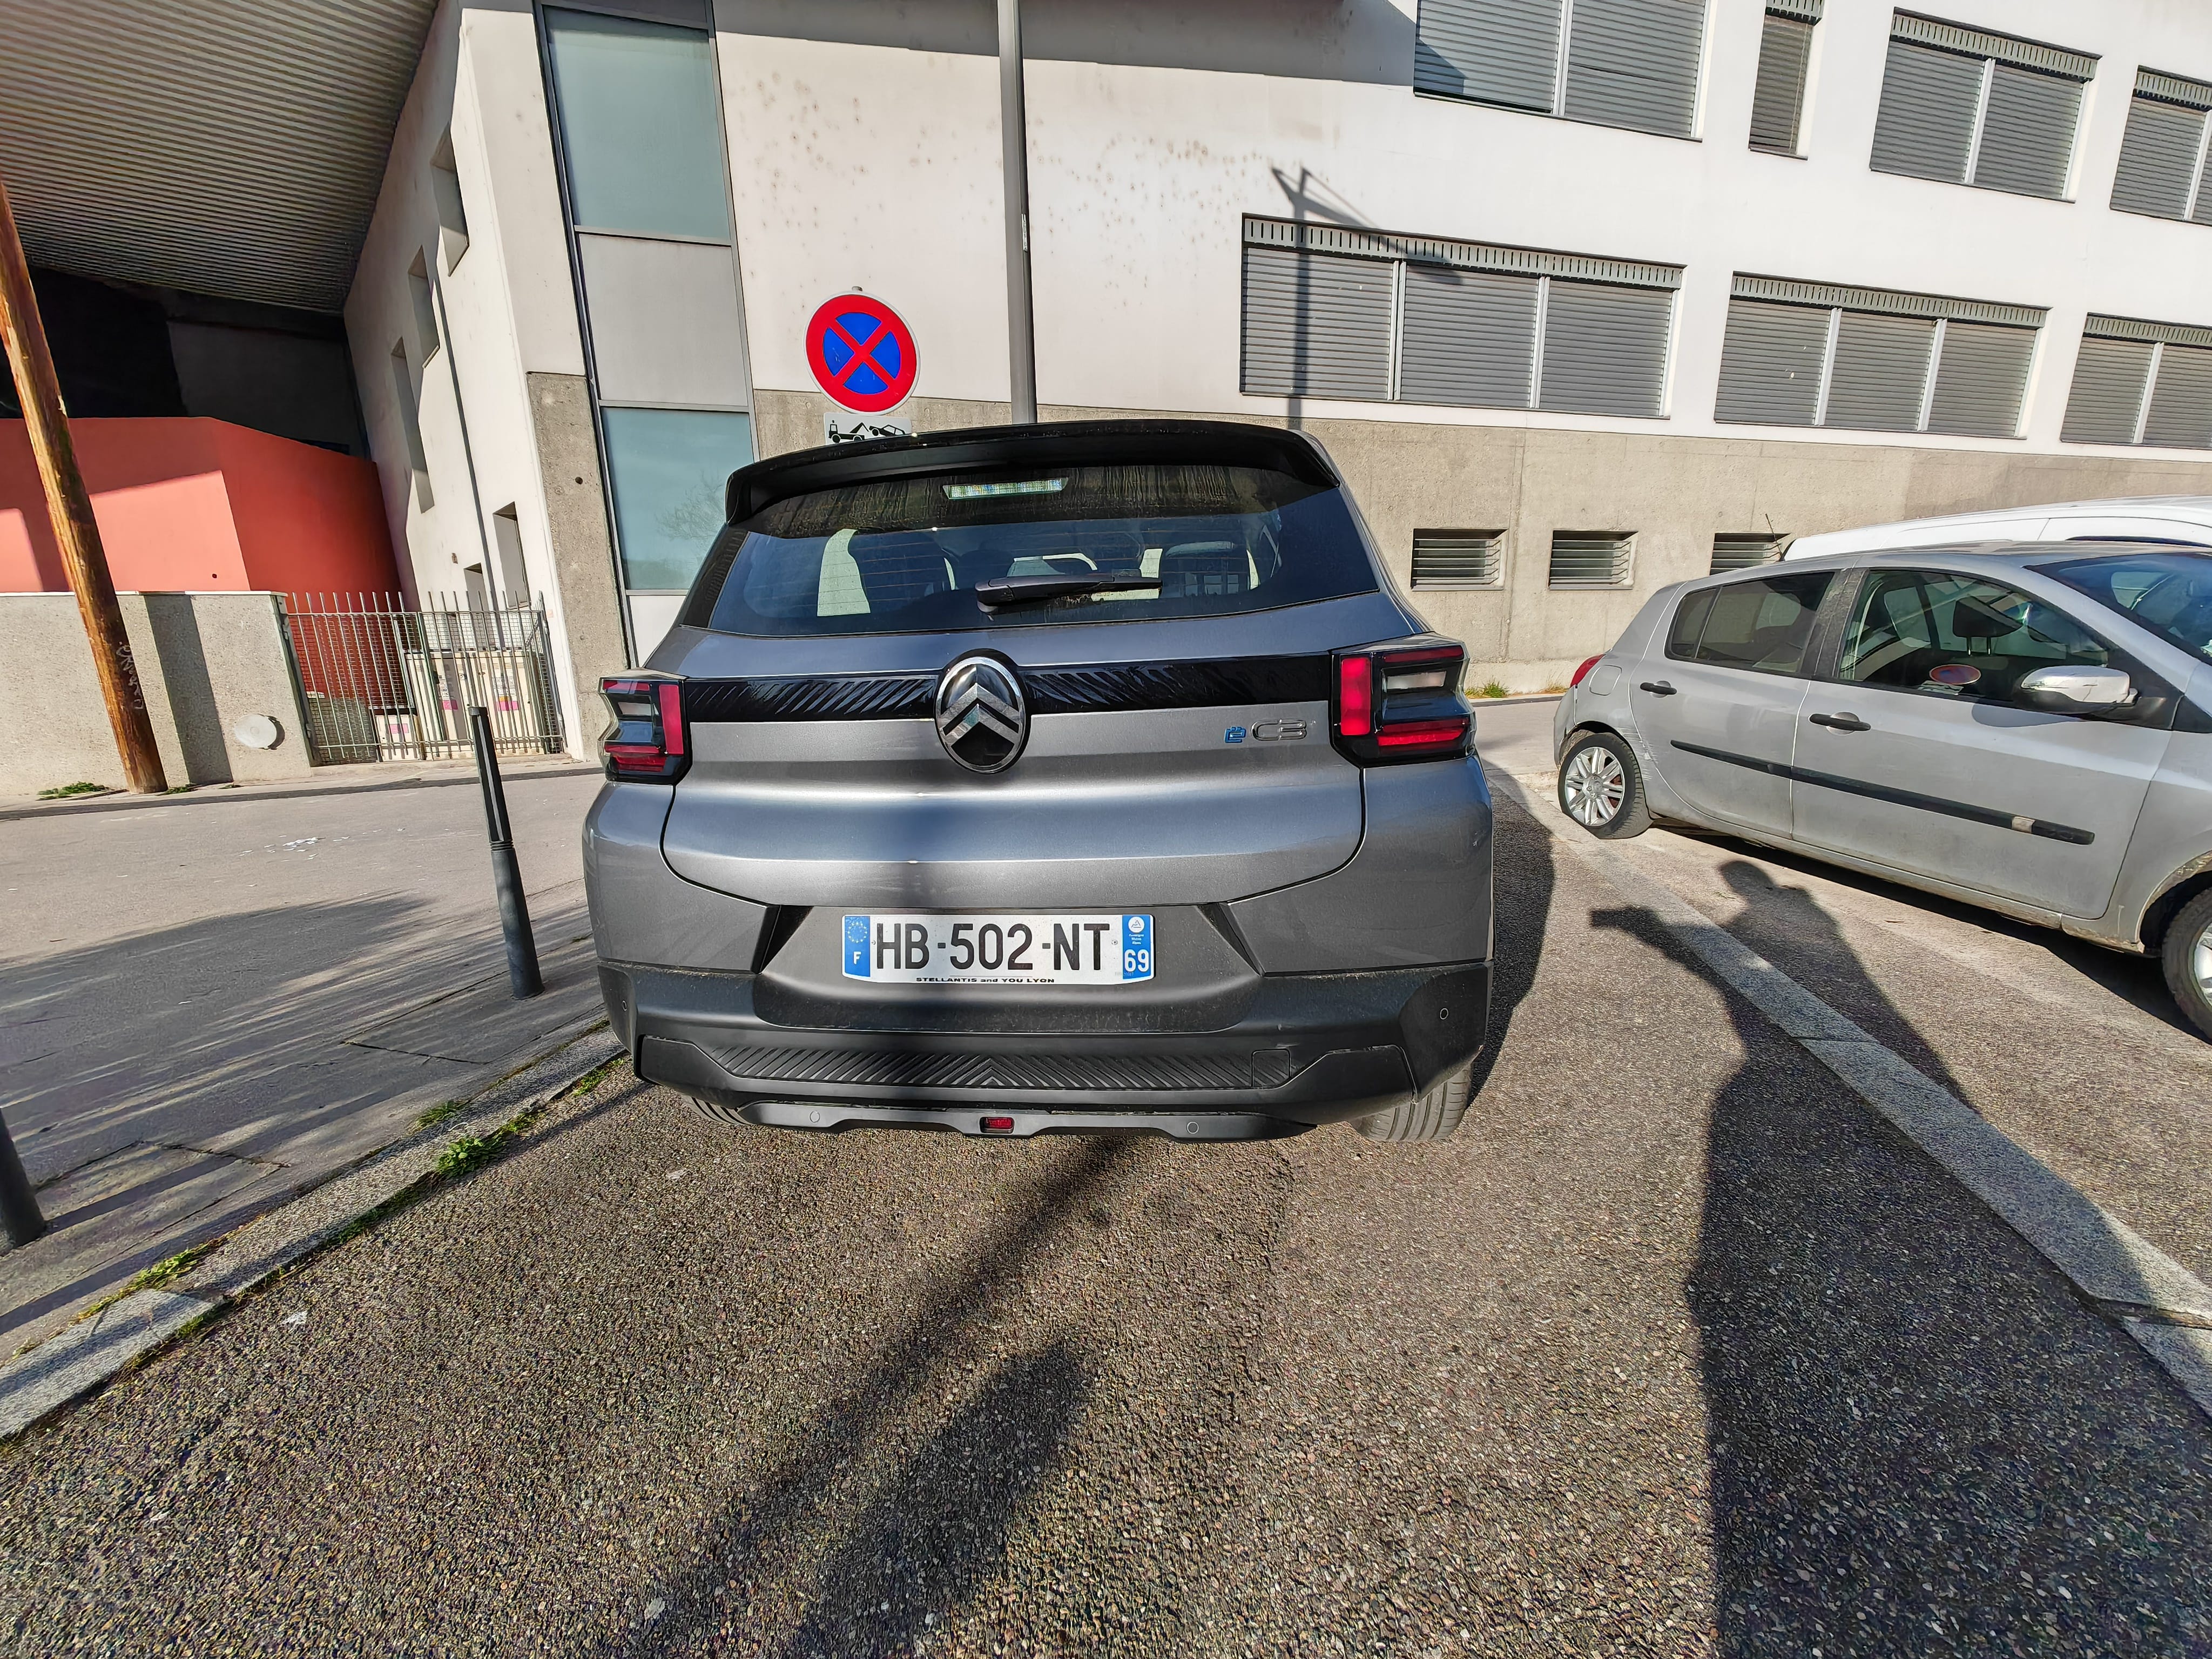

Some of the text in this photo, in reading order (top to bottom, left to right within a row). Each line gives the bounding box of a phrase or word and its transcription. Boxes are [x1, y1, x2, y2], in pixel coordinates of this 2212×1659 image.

[853, 951, 862, 965] F
[877, 923, 1110, 970] HB-502-NT
[1124, 949, 1149, 972] 69
